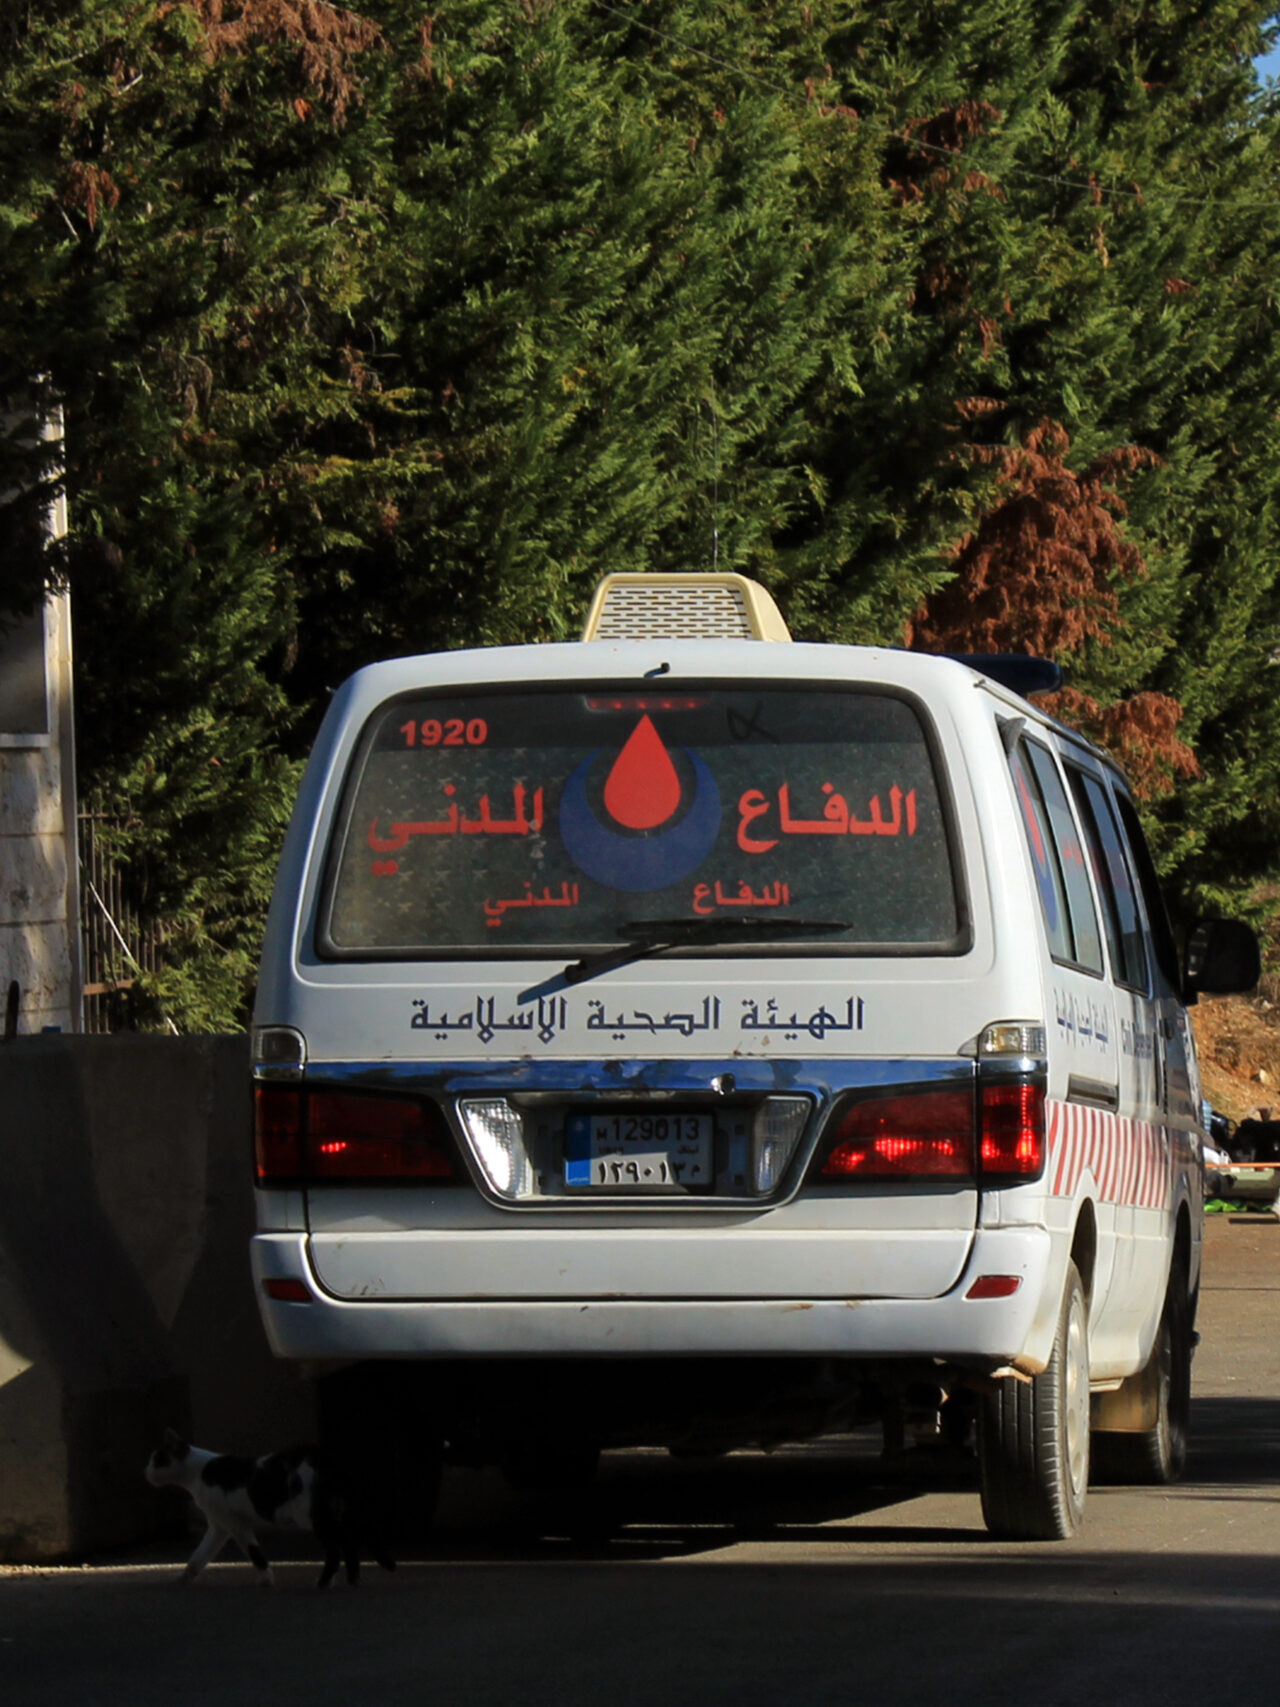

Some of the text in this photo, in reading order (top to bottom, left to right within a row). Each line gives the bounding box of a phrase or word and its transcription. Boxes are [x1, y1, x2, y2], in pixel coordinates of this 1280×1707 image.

[400, 718, 489, 747] 1920
[367, 782, 918, 878] الدفاع المدني
[483, 880, 790, 928] الدفاع المدني
[586, 996, 721, 1041] الصحية
[740, 996, 865, 1041] الهيئة
[611, 1118, 700, 1141] 129013
